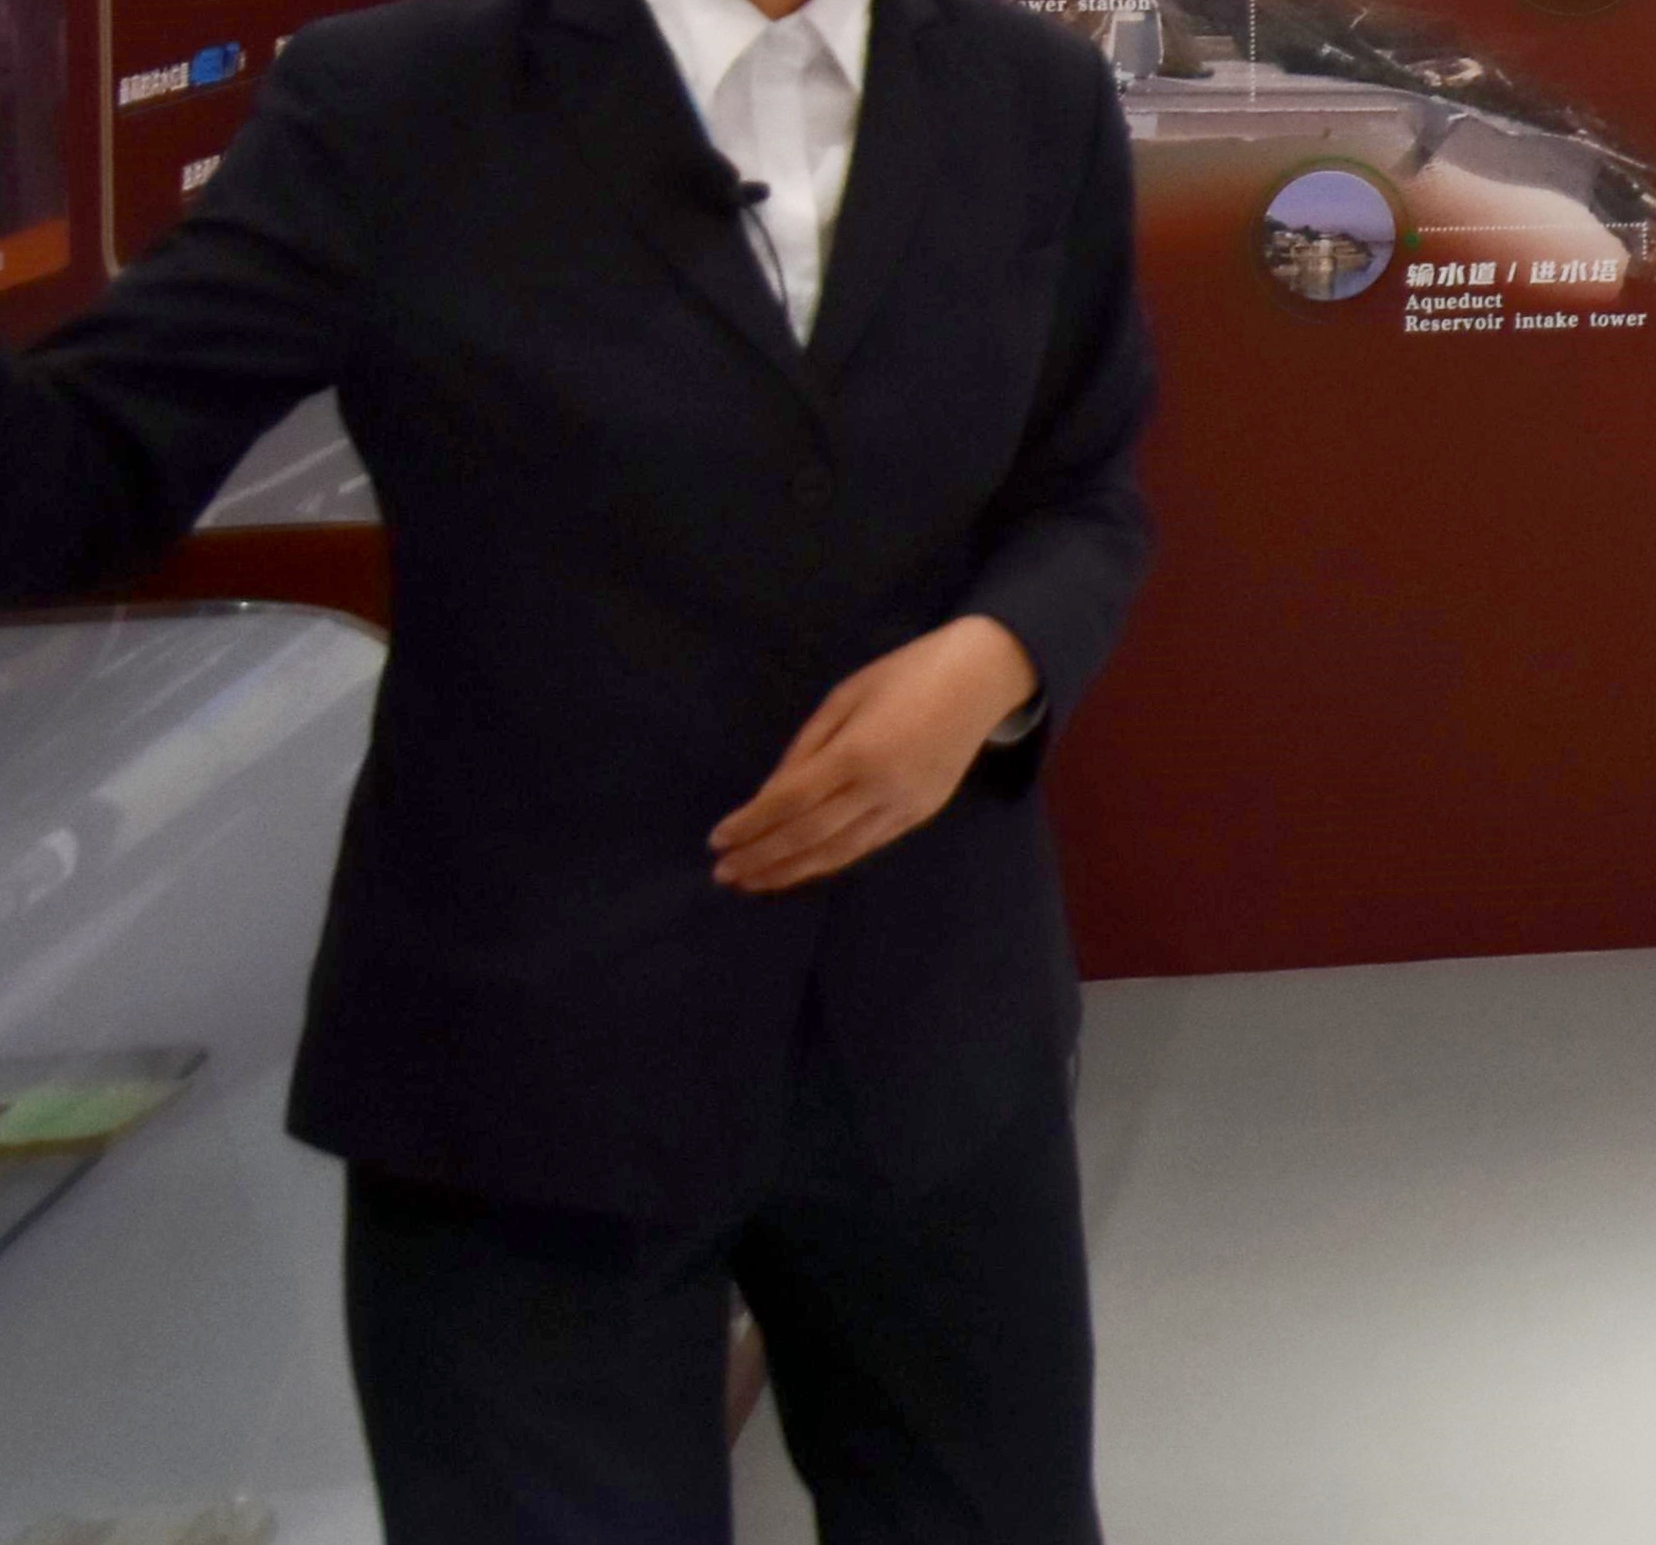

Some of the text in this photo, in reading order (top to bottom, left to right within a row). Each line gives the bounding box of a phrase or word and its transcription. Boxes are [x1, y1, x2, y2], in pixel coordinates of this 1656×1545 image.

[1405, 261, 1497, 288] 输水道
[1529, 258, 1619, 284] 进水塔
[1405, 292, 1504, 314] Aqueduct
[1404, 310, 1647, 333] Reservoir intake tower
